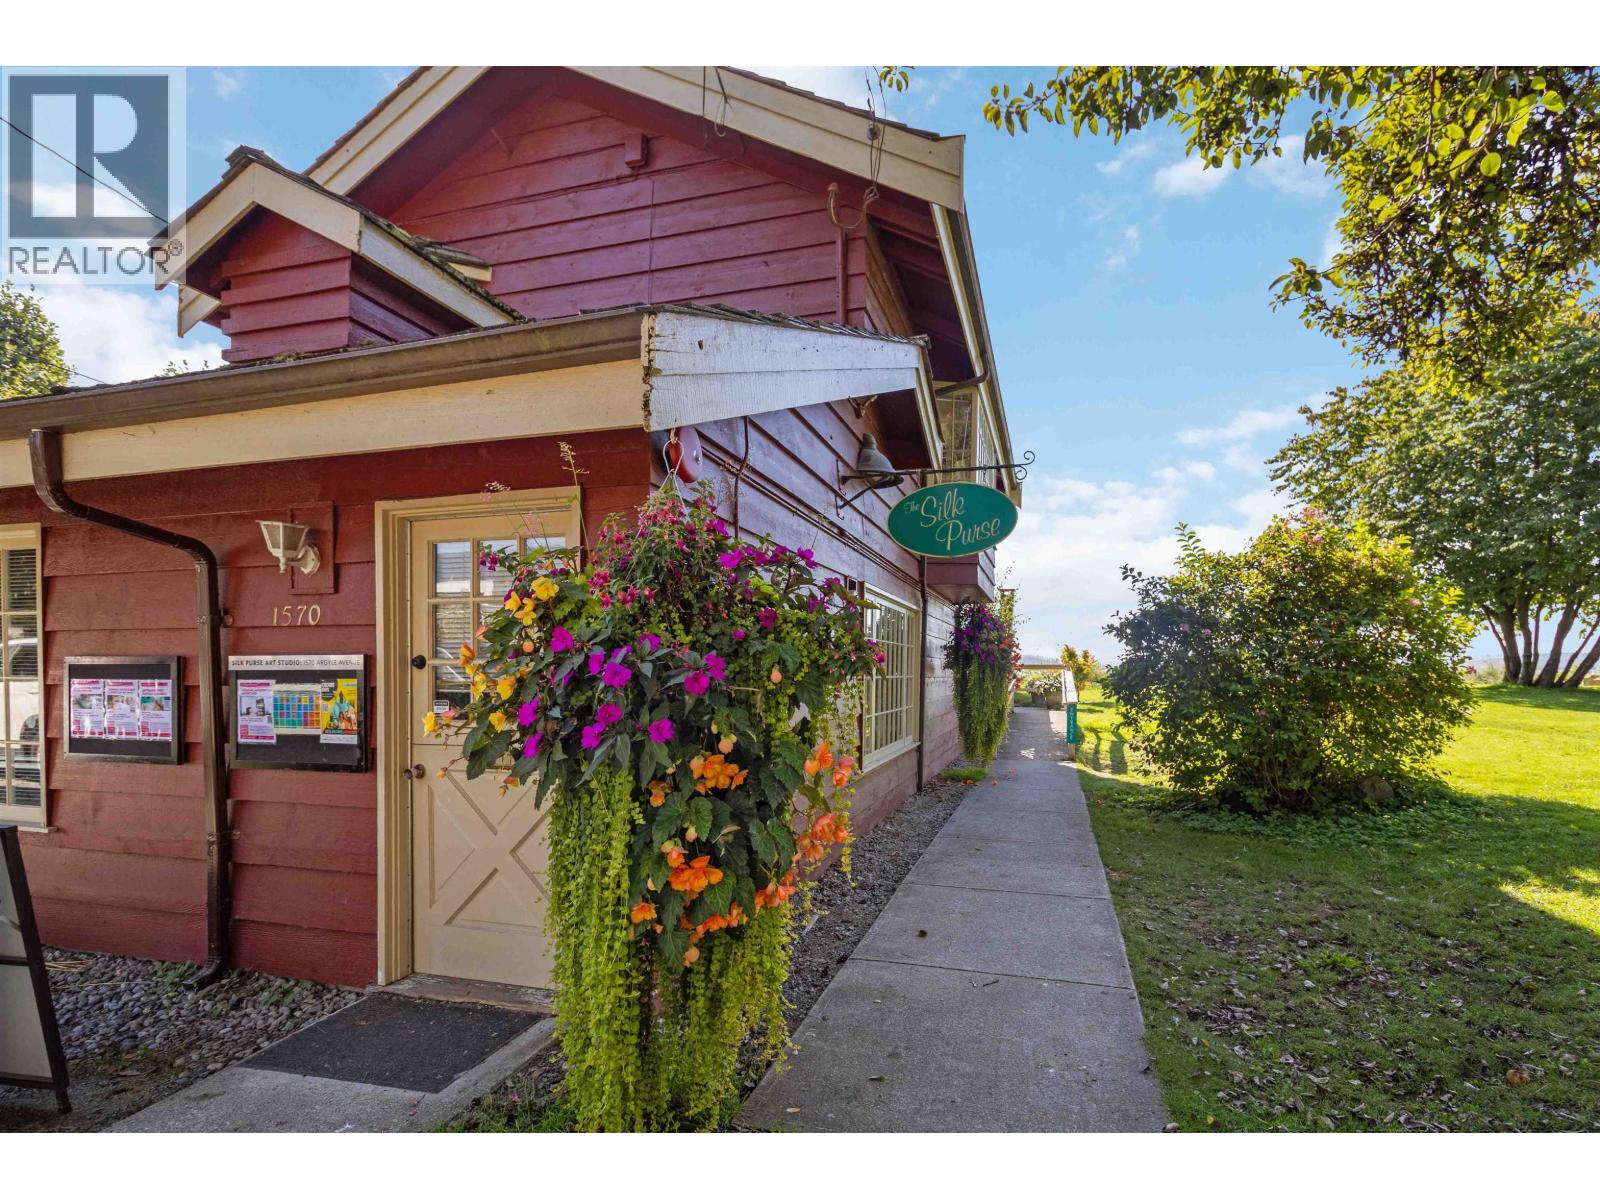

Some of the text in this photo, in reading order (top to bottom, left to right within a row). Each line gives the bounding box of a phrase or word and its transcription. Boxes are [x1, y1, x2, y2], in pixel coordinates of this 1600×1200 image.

[903, 487, 965, 528] The Silk
[935, 517, 1001, 551] Purse
[272, 604, 321, 627] 1570
[231, 659, 244, 667] SILK
[245, 659, 264, 667] PURSE
[265, 659, 276, 667] ART
